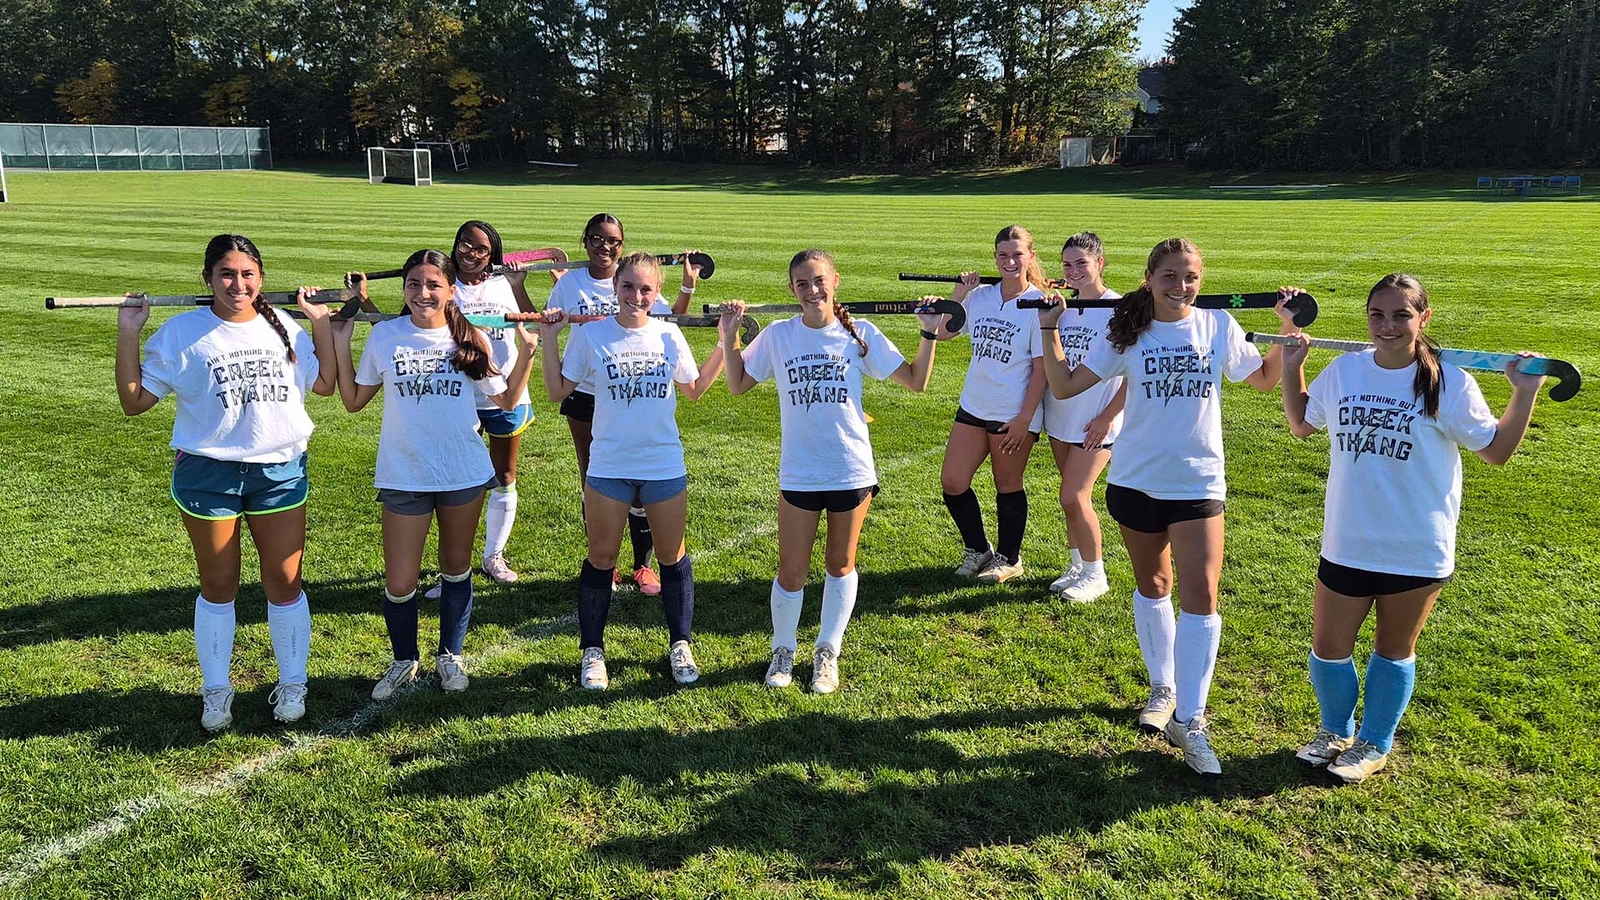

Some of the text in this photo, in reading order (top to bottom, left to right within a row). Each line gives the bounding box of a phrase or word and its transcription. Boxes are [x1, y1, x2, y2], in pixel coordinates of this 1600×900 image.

[874, 303, 908, 313] ritual
[973, 325, 1015, 346] CREEK
[1060, 335, 1092, 351] REEK
[207, 354, 226, 368] AIN'T
[229, 348, 263, 358] NOTHING
[784, 356, 799, 367] AIN'T
[801, 353, 829, 361] NOTHING
[831, 354, 844, 362] BUT
[972, 342, 1012, 364] THANG
[1141, 346, 1159, 357] AIN'T
[213, 360, 284, 385] CREEK
[606, 360, 667, 380] CREEK
[788, 364, 846, 384] CREEK
[1145, 355, 1212, 375] CREEK
[216, 384, 289, 409] THANG
[394, 379, 462, 397] THANG
[607, 381, 667, 400] THANG
[788, 386, 848, 406] THANG
[1142, 379, 1212, 399] THANG
[1338, 394, 1424, 416] AIN'T NOTHING BUT A
[1339, 406, 1415, 435] CREEK
[1336, 432, 1413, 461] THANG
